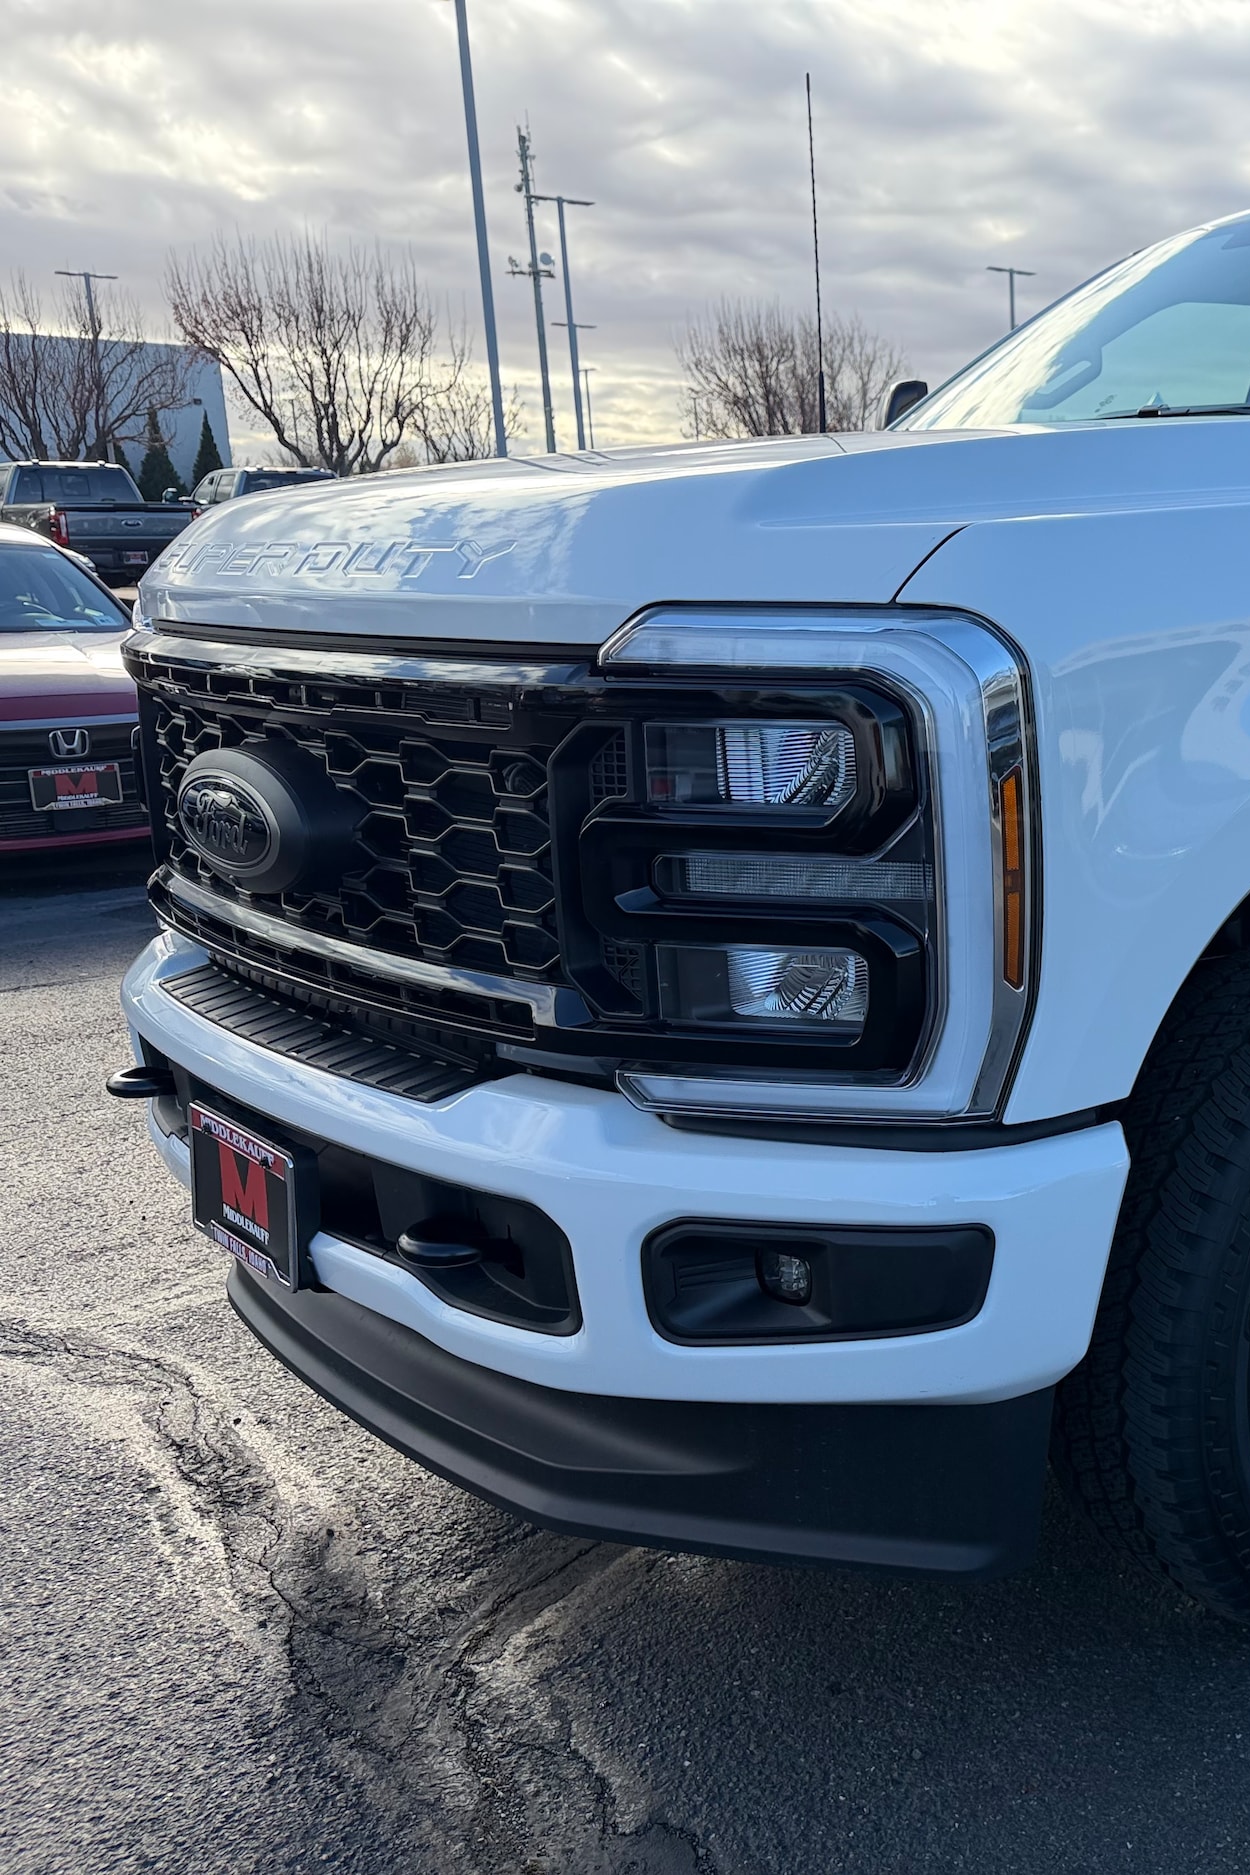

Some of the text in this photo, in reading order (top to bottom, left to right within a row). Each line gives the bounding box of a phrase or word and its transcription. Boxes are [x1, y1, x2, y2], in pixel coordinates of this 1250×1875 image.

[293, 540, 519, 580] DUTY
[55, 772, 98, 794] M
[194, 788, 249, 855] Ford
[218, 1142, 269, 1230] M
[222, 1203, 269, 1246] MIDDLEKAUFF
